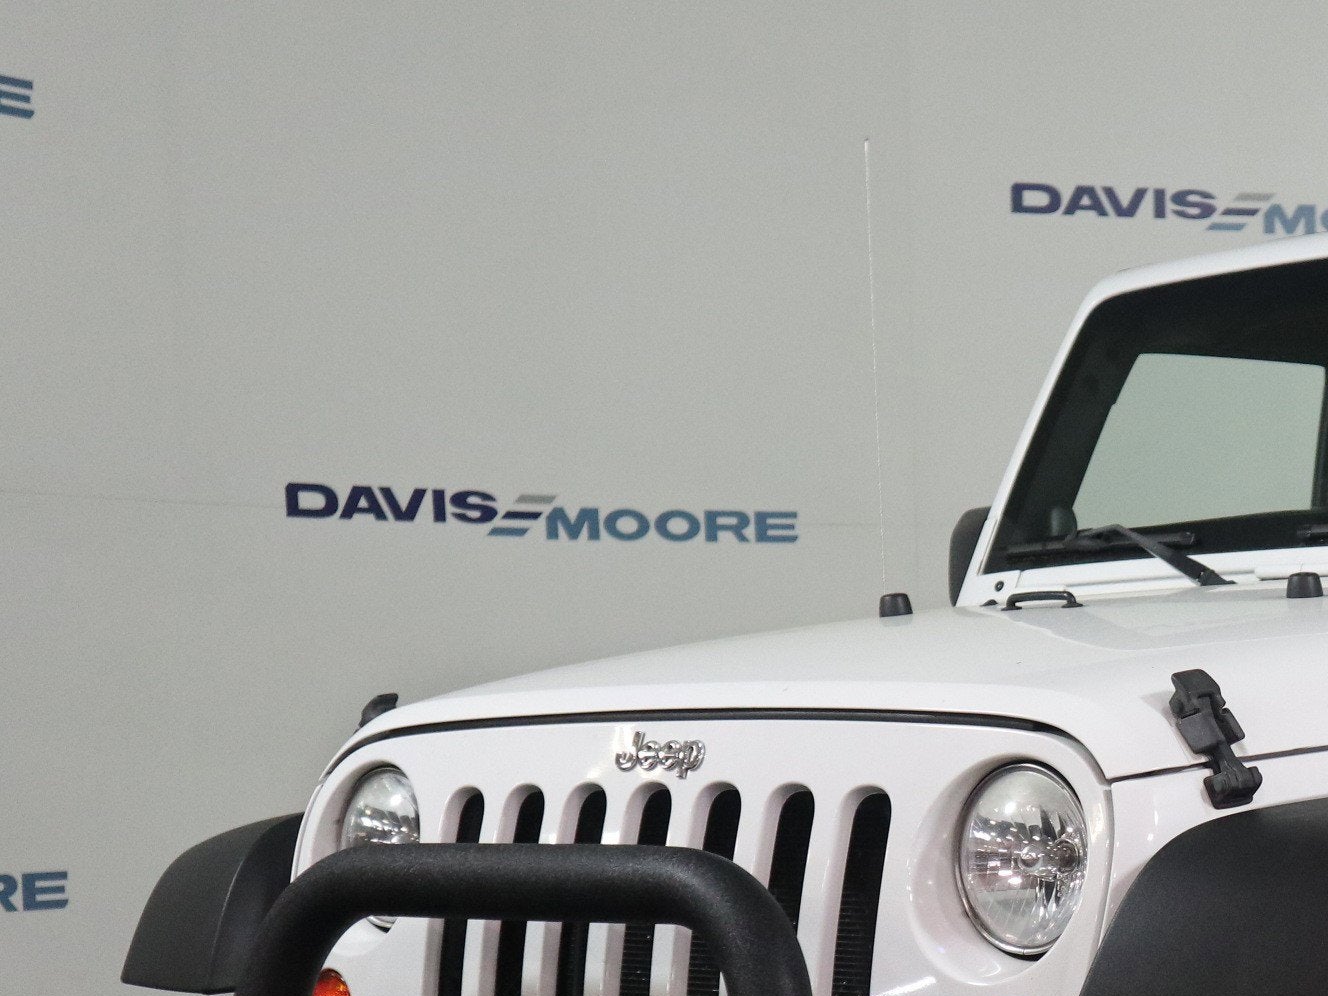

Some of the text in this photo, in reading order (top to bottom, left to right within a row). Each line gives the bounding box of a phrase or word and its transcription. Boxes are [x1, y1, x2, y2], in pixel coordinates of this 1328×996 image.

[1010, 182, 1218, 220] DAVIS
[284, 482, 799, 543] DAVIS MOORE
[615, 730, 706, 779] Jeep
